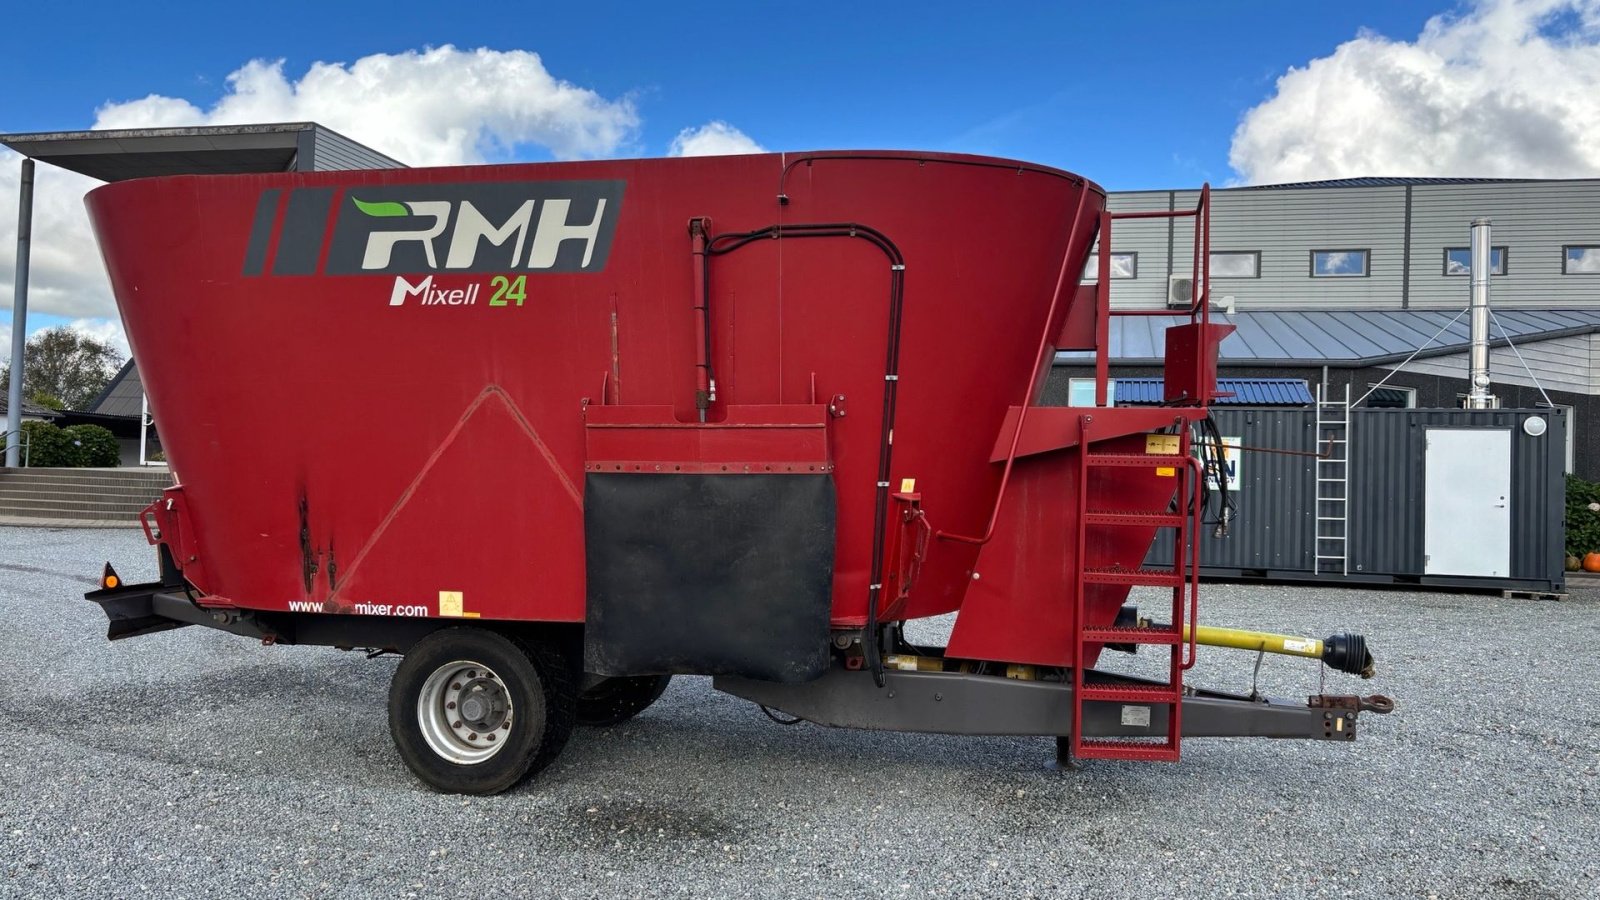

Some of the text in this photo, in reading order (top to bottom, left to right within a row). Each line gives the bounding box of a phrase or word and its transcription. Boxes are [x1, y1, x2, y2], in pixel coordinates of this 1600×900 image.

[352, 196, 607, 270] RMH
[389, 275, 527, 306] Mixell 24
